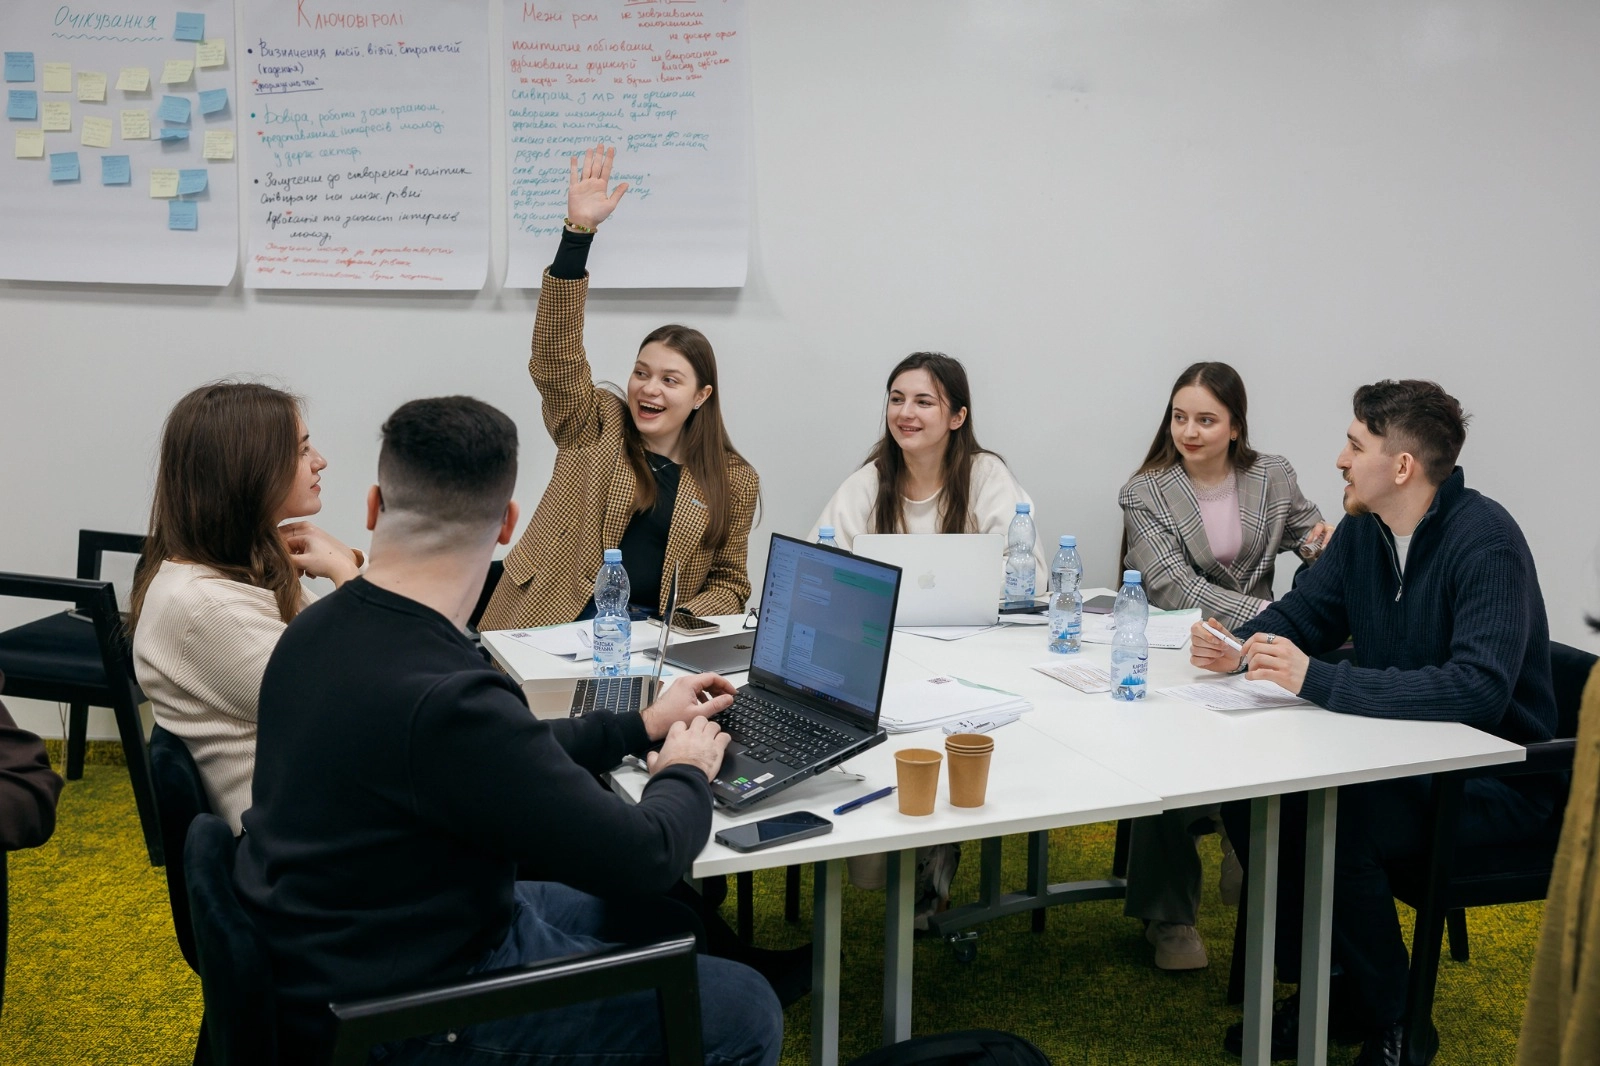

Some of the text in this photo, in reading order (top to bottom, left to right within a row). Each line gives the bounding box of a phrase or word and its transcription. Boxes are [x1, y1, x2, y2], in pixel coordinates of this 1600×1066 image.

[55, 5, 157, 30] Очікування
[371, 9, 404, 28] ролі
[522, 2, 599, 29] Межі ролі
[258, 38, 326, 59] Визначення
[399, 41, 463, 58] стратегій
[512, 38, 654, 52] політичне лобіювання
[511, 87, 574, 104] Співпраця
[643, 90, 696, 102] органами
[319, 108, 356, 128] робота
[261, 129, 339, 148] представлення
[341, 121, 392, 138] інтересів
[546, 135, 615, 145] експертиза
[274, 151, 282, 168] у
[515, 149, 551, 163] резерв
[265, 166, 472, 191] Залучення до створення політик
[260, 191, 318, 206] Співпраця
[325, 193, 343, 201] на
[386, 185, 423, 205] рівні
[398, 211, 460, 226] інтересів
